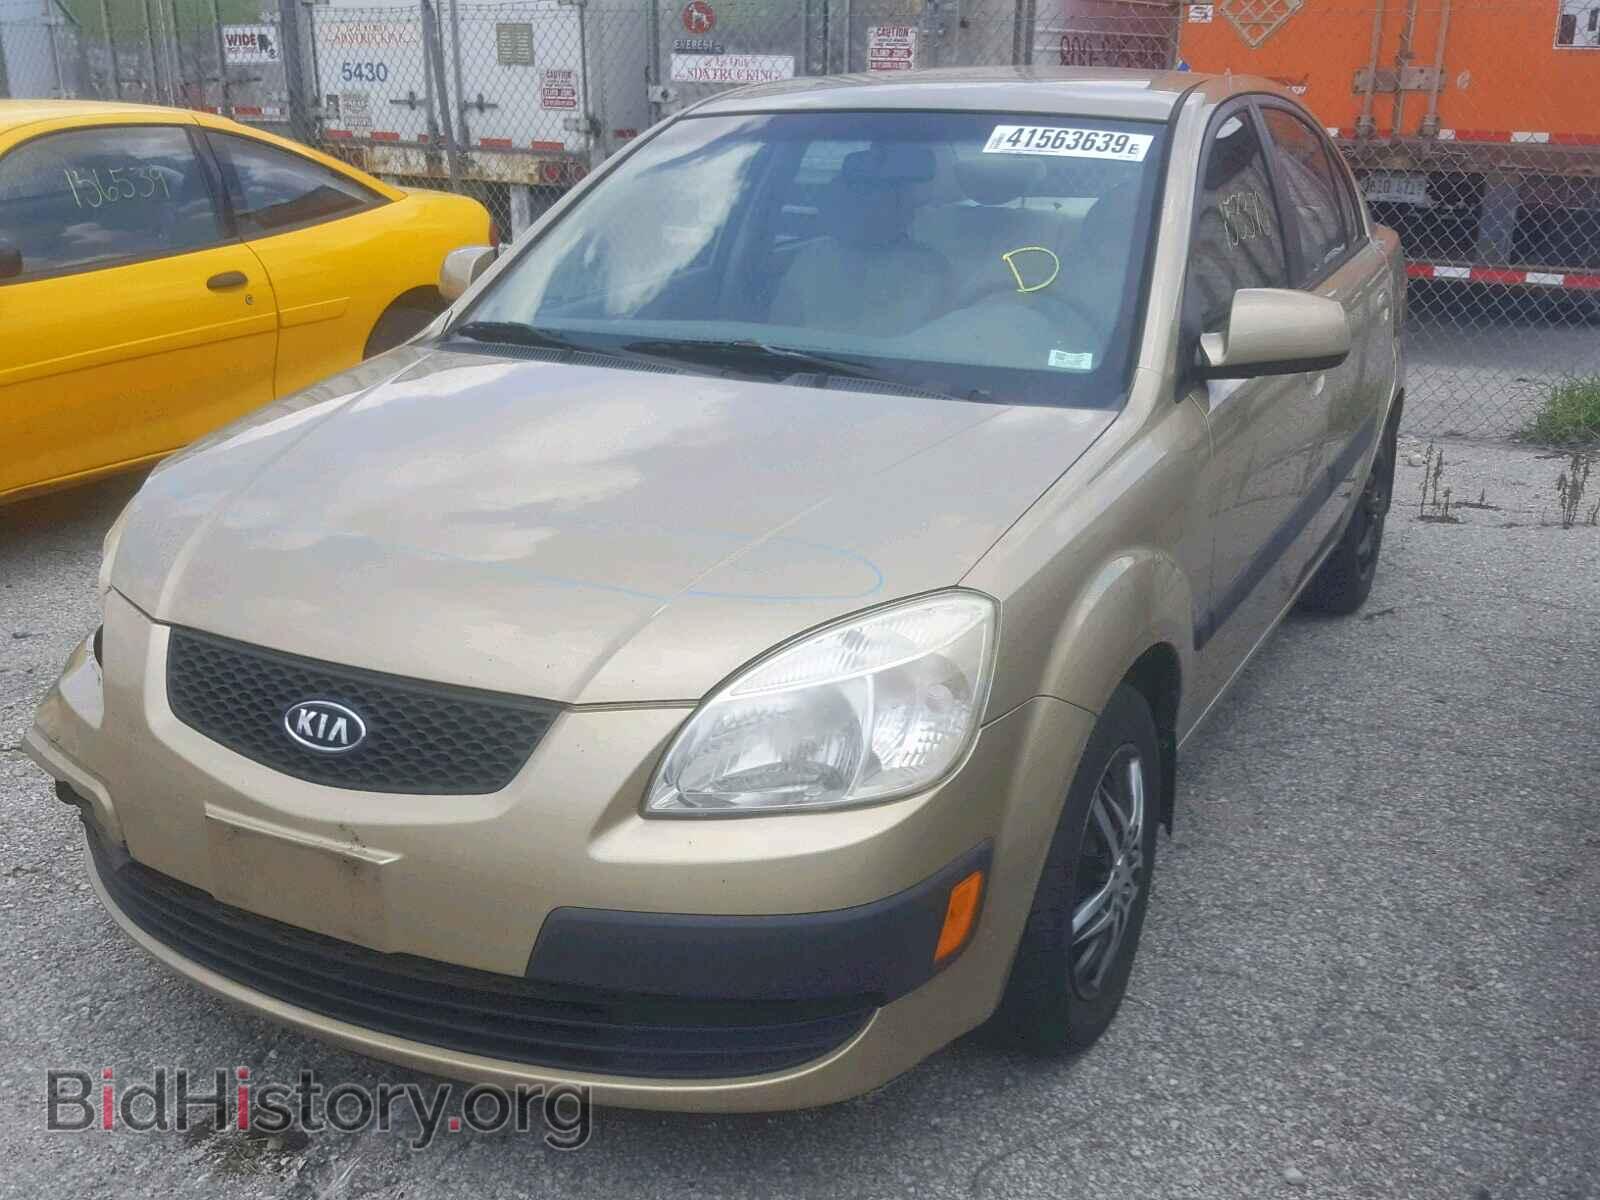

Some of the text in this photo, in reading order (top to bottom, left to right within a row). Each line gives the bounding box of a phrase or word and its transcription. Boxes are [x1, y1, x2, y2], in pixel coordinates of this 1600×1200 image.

[225, 33, 257, 46] WIDE
[341, 61, 389, 82] 5430
[1006, 127, 1130, 154] 41563639
[296, 708, 349, 745] KIA
